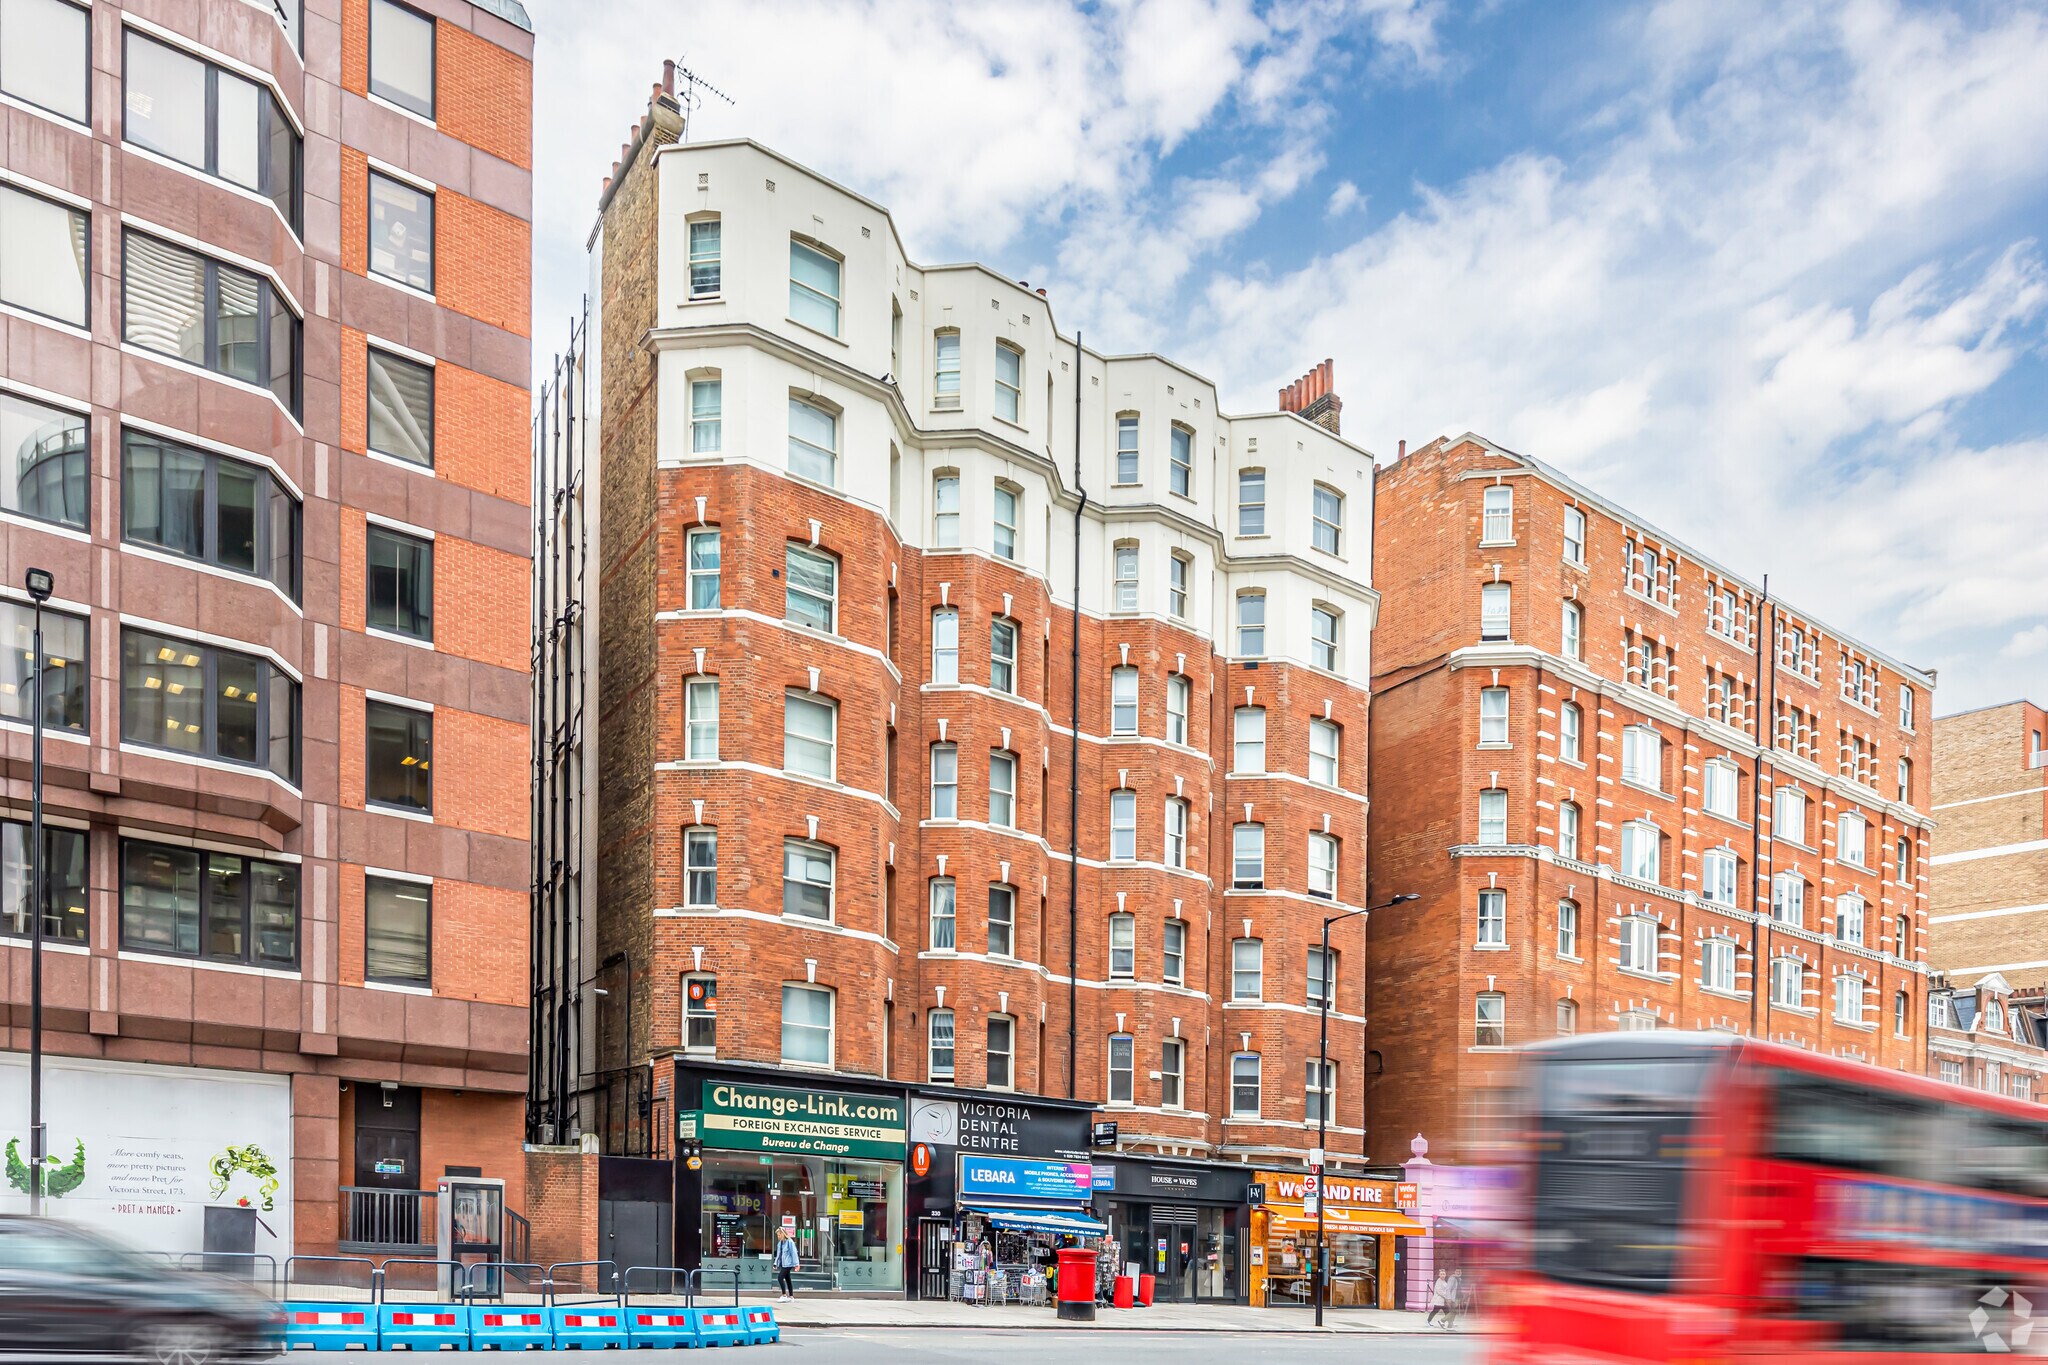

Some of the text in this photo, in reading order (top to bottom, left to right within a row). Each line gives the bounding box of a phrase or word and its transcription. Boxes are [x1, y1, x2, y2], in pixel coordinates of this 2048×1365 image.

[712, 1086, 898, 1122] Change-Link.com
[960, 1102, 1031, 1121] VICTORIA
[733, 1118, 882, 1139] FOREIGN EXCHANGE SERVICE
[960, 1118, 1018, 1135] DENTAL
[761, 1136, 850, 1152] Bureau de Change
[960, 1134, 1019, 1151] CENTRE
[111, 1148, 135, 1157] More
[135, 1150, 161, 1160] comfy
[130, 1163, 154, 1171] pretty
[155, 1164, 187, 1172] pictures
[1311, 1165, 1318, 1174] U
[111, 1173, 130, 1181] and
[151, 1175, 167, 1183] Pret
[970, 1168, 1016, 1184] LEBARA
[1151, 1175, 1173, 1184] HOUSE
[1178, 1177, 1198, 1186] VAPES
[1093, 1179, 1111, 1187] LEBARA
[108, 1185, 140, 1194] Victoria
[142, 1187, 167, 1195] Street,
[1322, 1185, 1351, 1201] AND
[1353, 1186, 1383, 1203] FIRE
[118, 1204, 175, 1215] PRET A MANGER
[1398, 1200, 1416, 1208] FIRE
